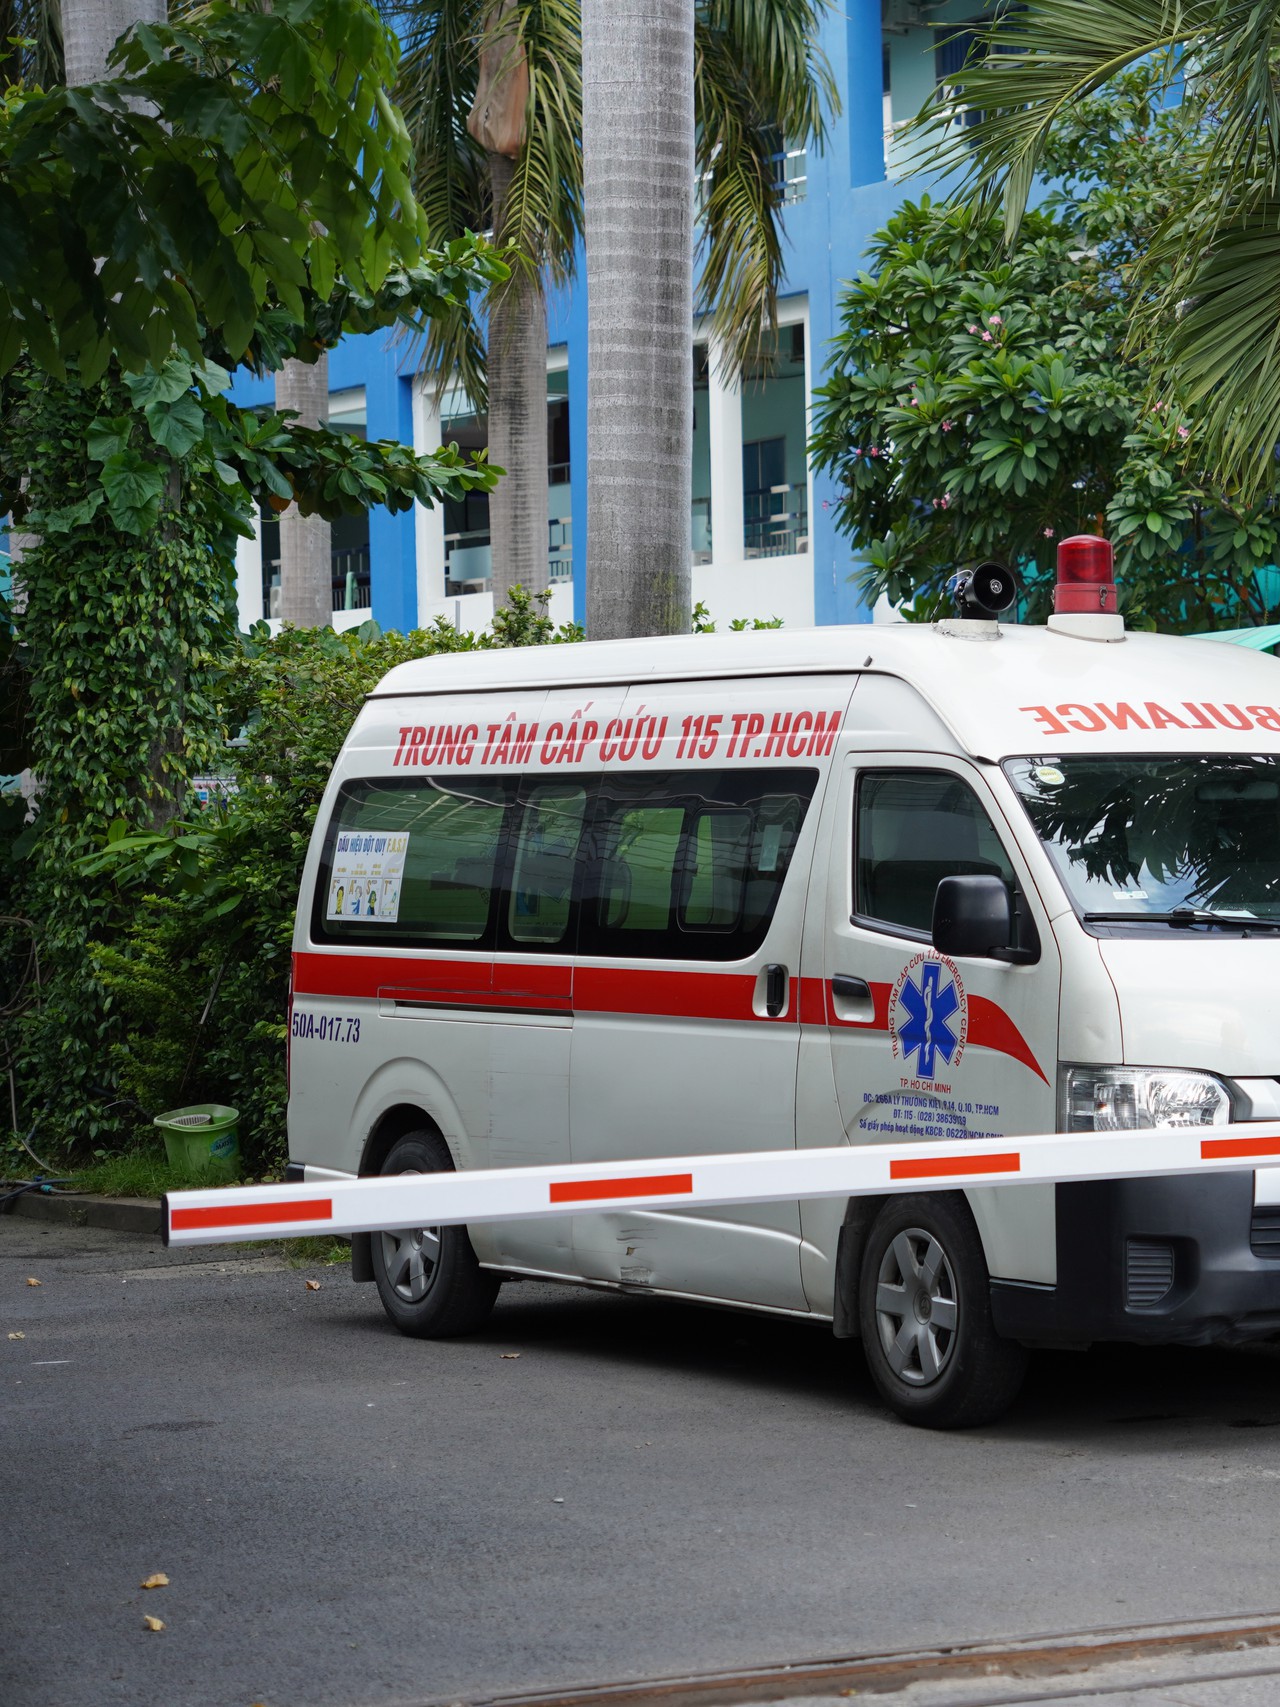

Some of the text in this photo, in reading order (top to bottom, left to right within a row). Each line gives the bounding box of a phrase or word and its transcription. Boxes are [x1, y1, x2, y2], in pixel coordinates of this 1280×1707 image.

[393, 702, 842, 766] TRUNG TÂM CẤP CỨU 115 TP.HCM
[292, 1012, 360, 1043] 50A-017.73
[889, 1017, 898, 1060] TRUNG
[941, 954, 967, 1014] EMERGENCY
[954, 1018, 966, 1067] CENTER
